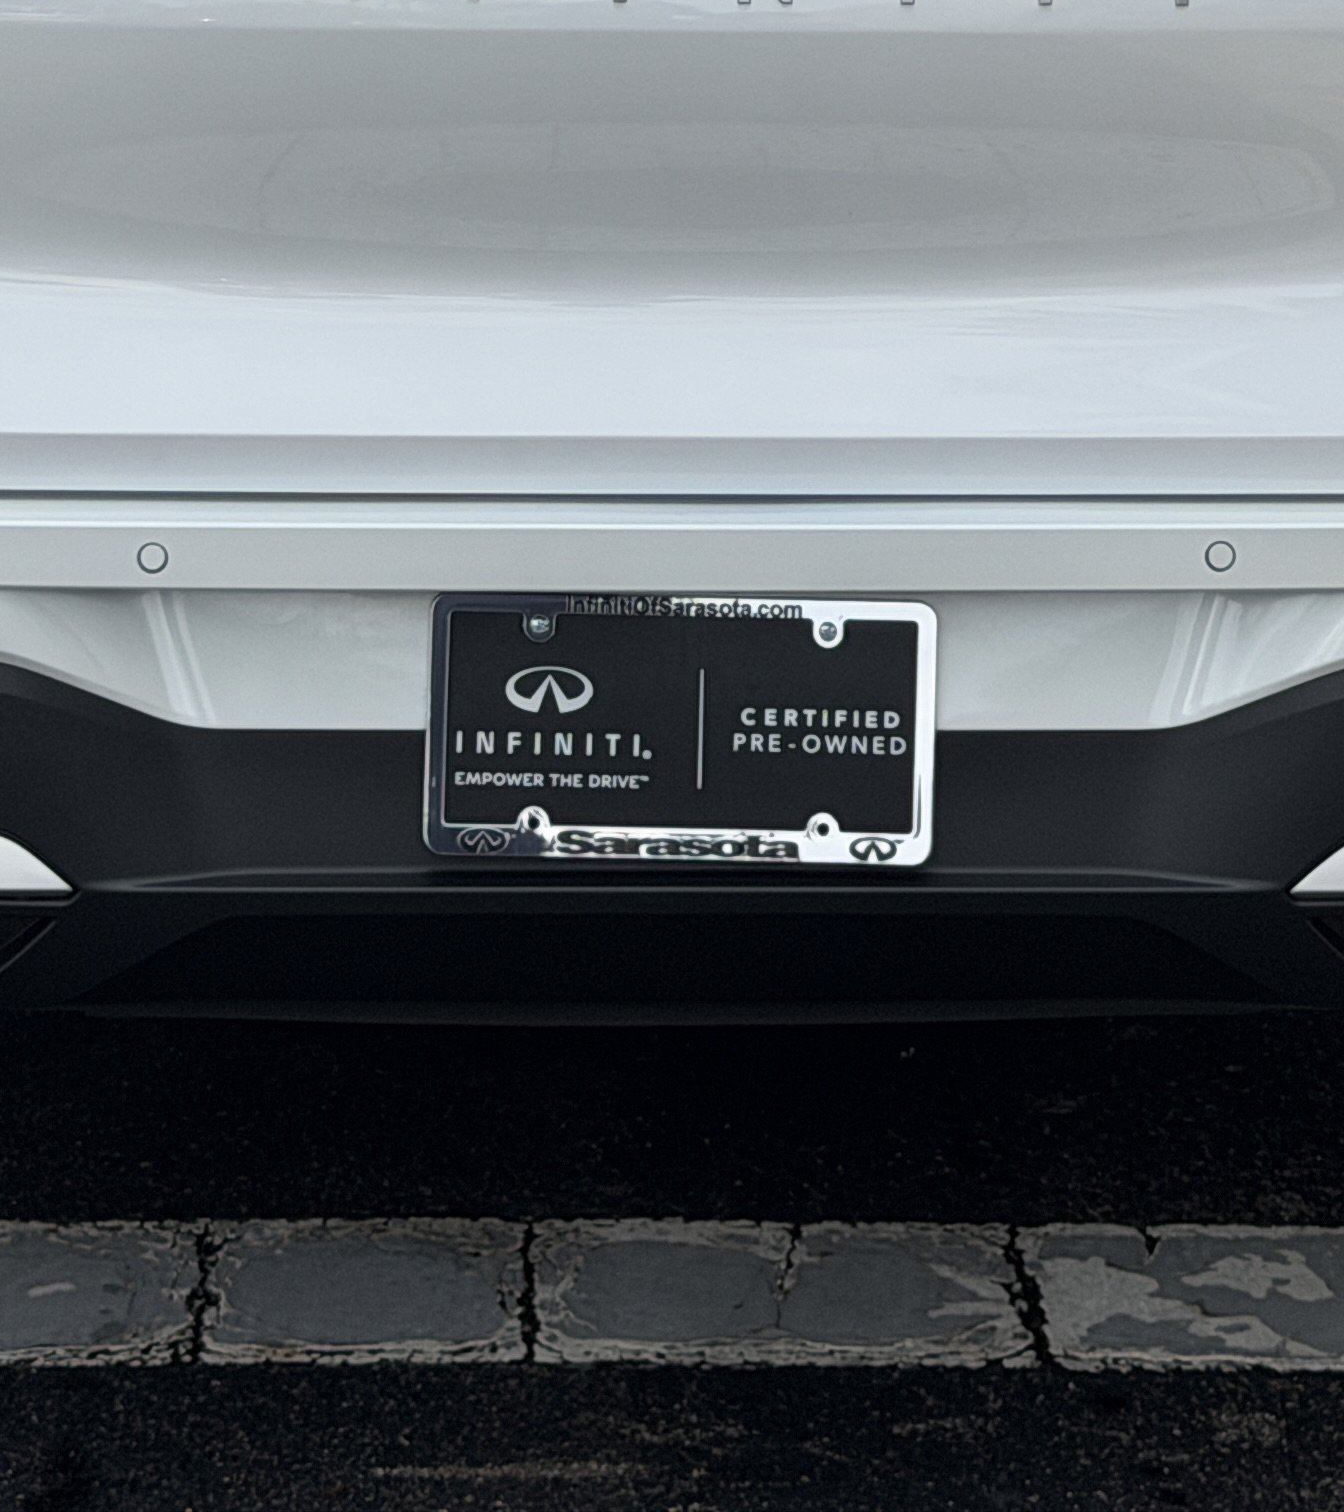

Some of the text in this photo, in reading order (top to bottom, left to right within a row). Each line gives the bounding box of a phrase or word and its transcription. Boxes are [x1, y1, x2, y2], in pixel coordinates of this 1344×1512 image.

[740, 707, 901, 729] CERTIFIED
[455, 730, 640, 757] INFINITI
[732, 732, 907, 756] PRE-OWNED
[454, 771, 544, 787] EMPOWER
[549, 773, 583, 788] THE
[556, 829, 799, 863] Sarasota
